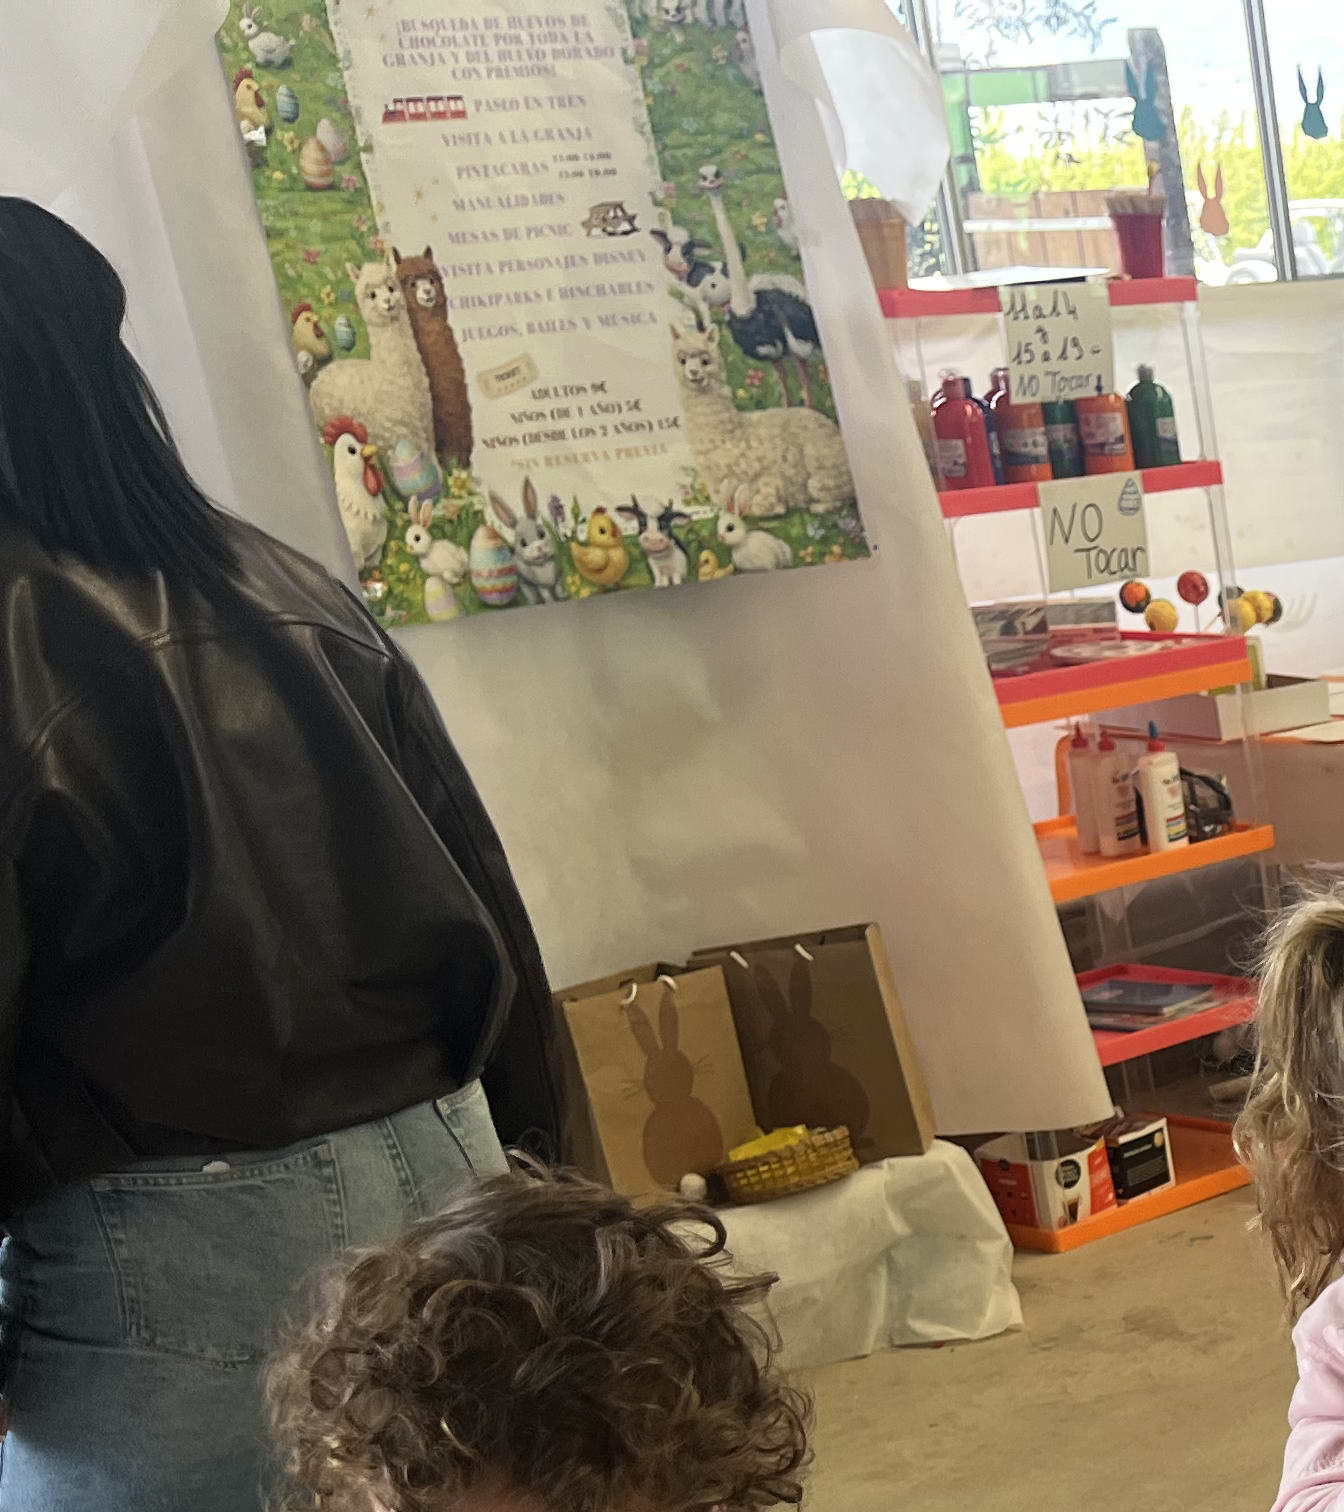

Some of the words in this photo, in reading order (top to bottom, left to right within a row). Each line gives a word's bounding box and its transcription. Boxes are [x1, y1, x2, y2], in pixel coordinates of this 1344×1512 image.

[398, 33, 489, 49] CHOCOLATE
[382, 51, 447, 68] GRANJA
[441, 130, 493, 148] VISITA
[533, 126, 594, 143] GRANJA
[452, 192, 566, 212] MANUALIDADES
[448, 228, 499, 246] MESAS
[441, 261, 494, 279] VISITA
[592, 248, 647, 267] DISNEY
[1015, 373, 1040, 398] NO
[1049, 501, 1103, 546] NO
[1073, 545, 1146, 580] Tocar
